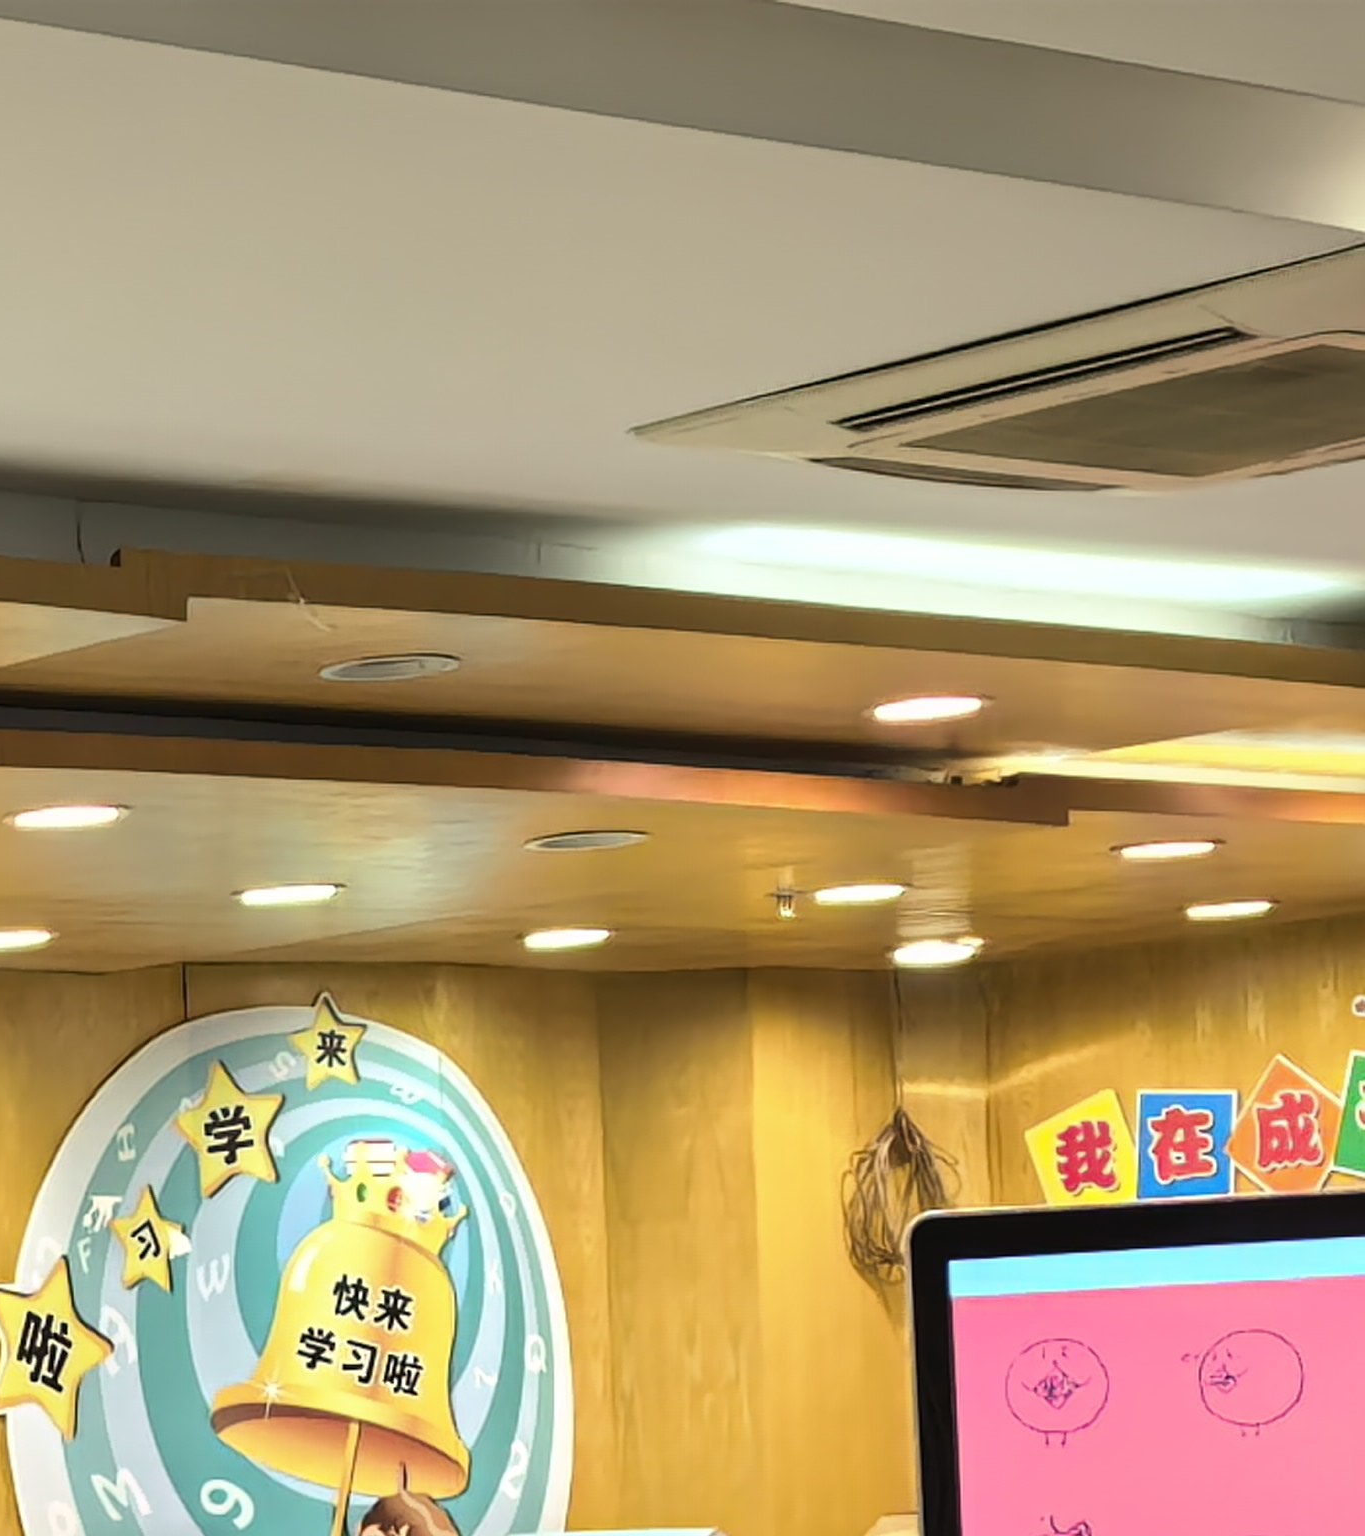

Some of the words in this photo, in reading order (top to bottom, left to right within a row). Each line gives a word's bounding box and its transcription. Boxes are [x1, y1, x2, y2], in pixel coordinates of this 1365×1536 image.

[316, 1029, 347, 1068] 来
[204, 1105, 254, 1165] 学
[1056, 1092, 1365, 1193] 我在成
[131, 1219, 161, 1260] 习
[332, 1274, 413, 1332] 快来
[16, 1310, 73, 1393] 啦
[296, 1326, 424, 1397] 学习啦
